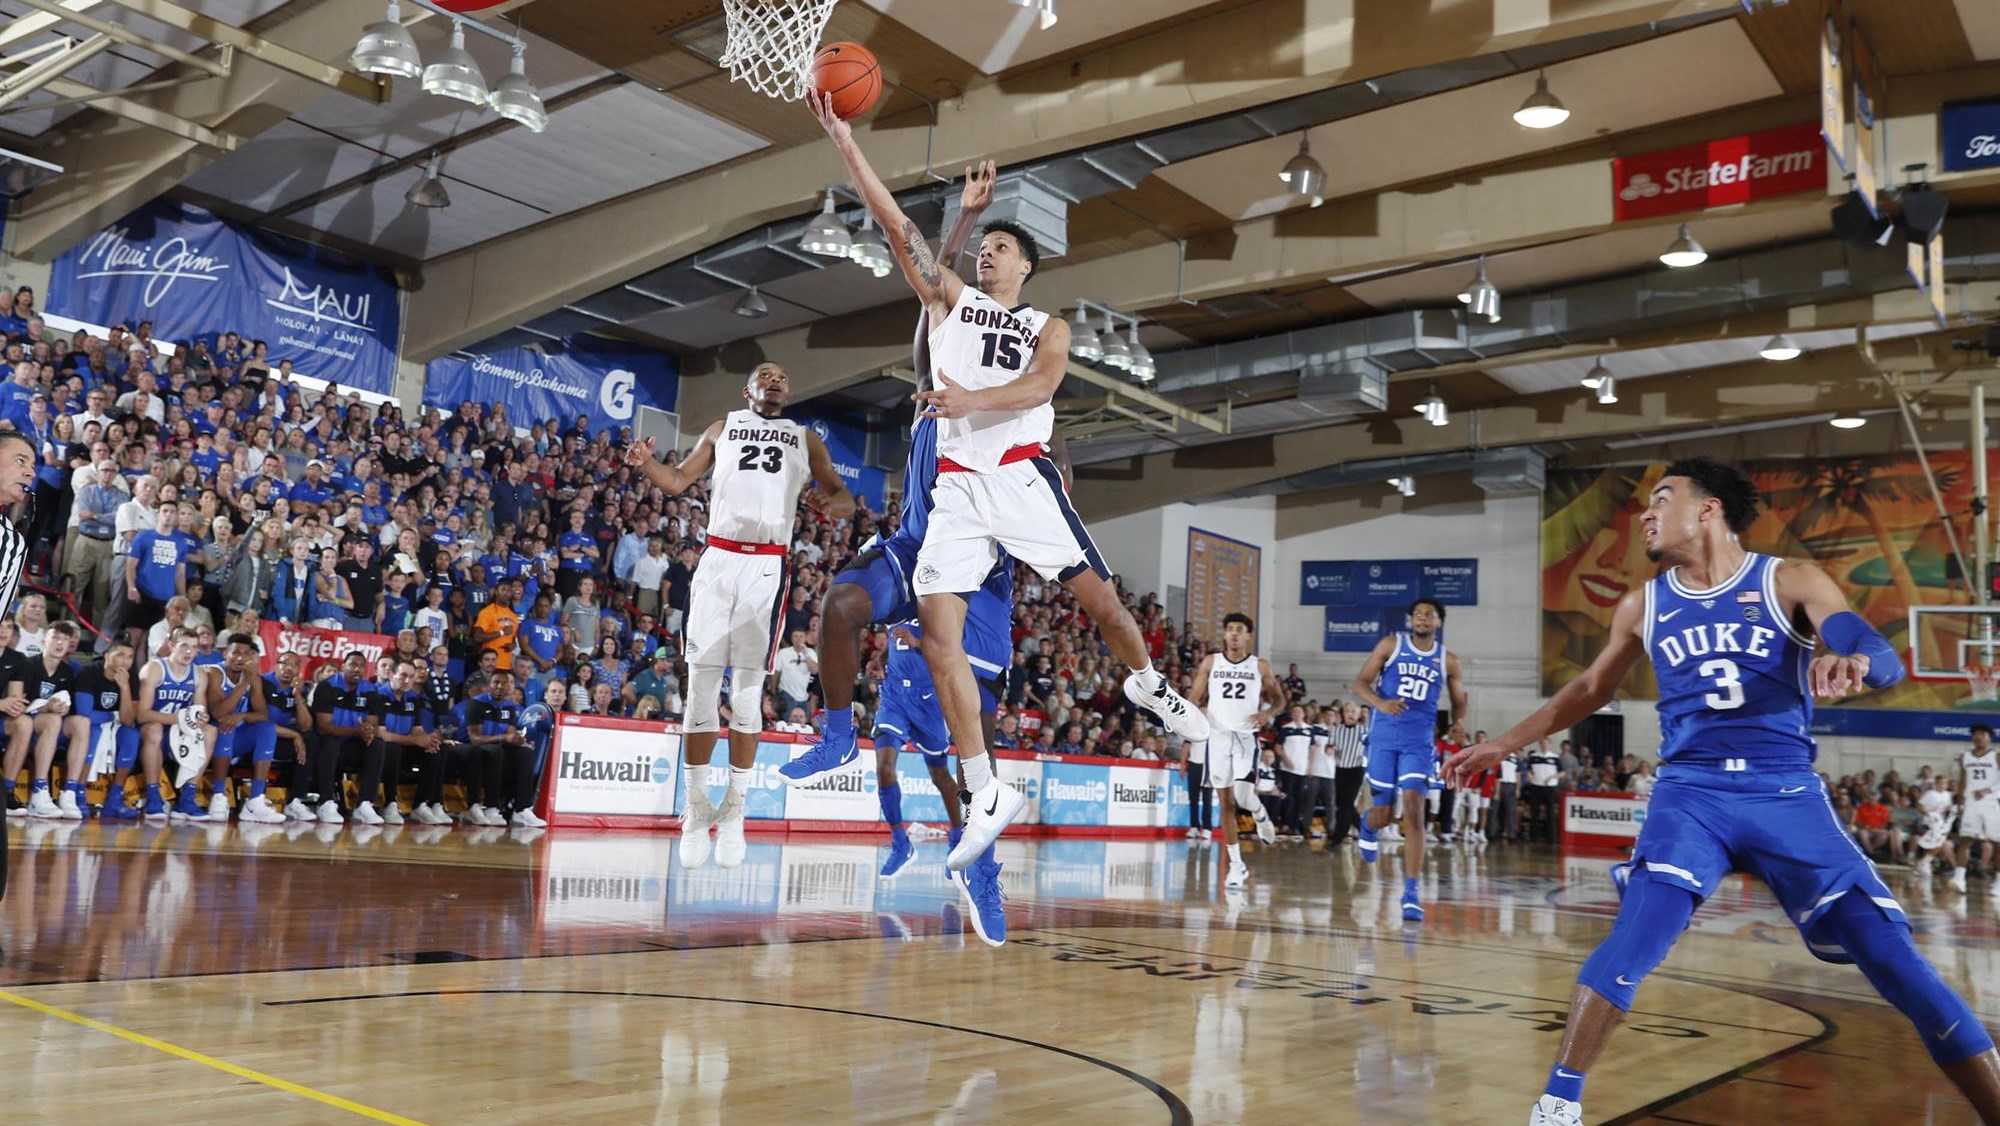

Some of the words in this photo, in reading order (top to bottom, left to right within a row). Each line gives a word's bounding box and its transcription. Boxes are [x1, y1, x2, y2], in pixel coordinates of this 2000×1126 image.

[79, 225, 147, 271] Maui
[144, 237, 229, 307] Jim
[279, 266, 370, 326] MAUI
[960, 305, 1040, 353] GONZAGA
[981, 332, 1022, 371] 15
[728, 428, 800, 449] GONZAGA
[738, 444, 784, 474] 23
[1658, 623, 1777, 667] DUKE
[1212, 670, 1256, 681] GONZAGA
[1397, 662, 1440, 683] DUKE
[1222, 681, 1247, 699] 22
[1396, 676, 1430, 701] 20
[1699, 658, 1746, 711] 3
[1933, 726, 1971, 735] HOME
[559, 751, 652, 783] Hawaii
[1972, 769, 1987, 780] 21
[1046, 778, 1094, 800] Hawaii
[1113, 783, 1156, 804] Hawaii
[1569, 803, 1632, 822] Hawaii
